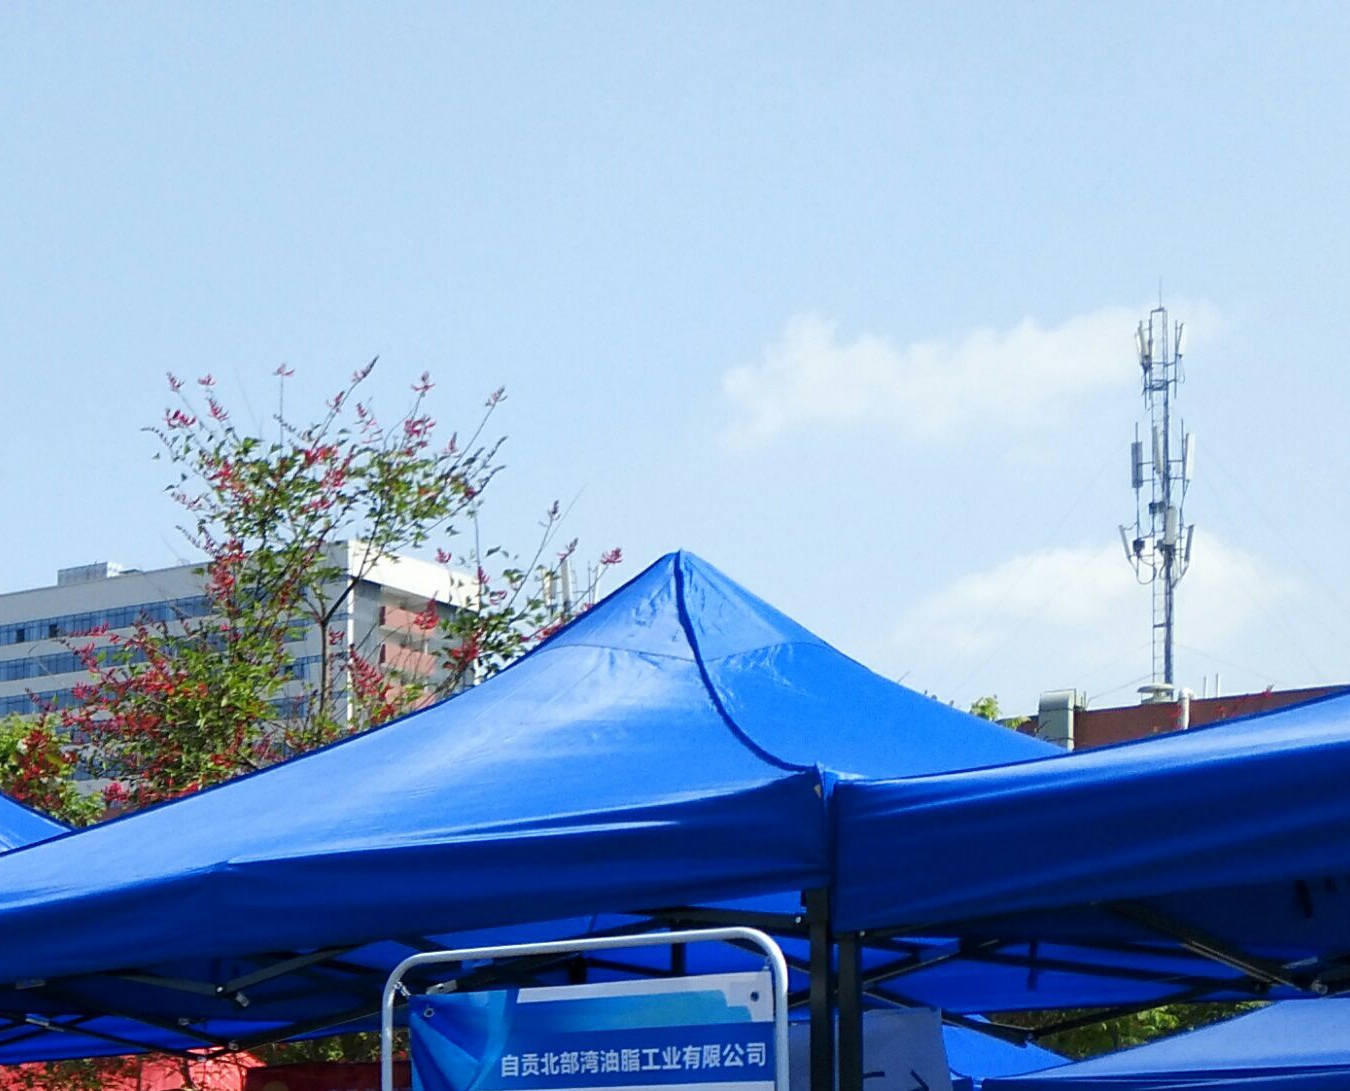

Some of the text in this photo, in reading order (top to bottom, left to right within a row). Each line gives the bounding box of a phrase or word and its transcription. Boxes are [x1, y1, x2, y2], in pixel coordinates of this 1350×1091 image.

[501, 1042, 767, 1078] 自贡北部湾油脂工业有限公司
